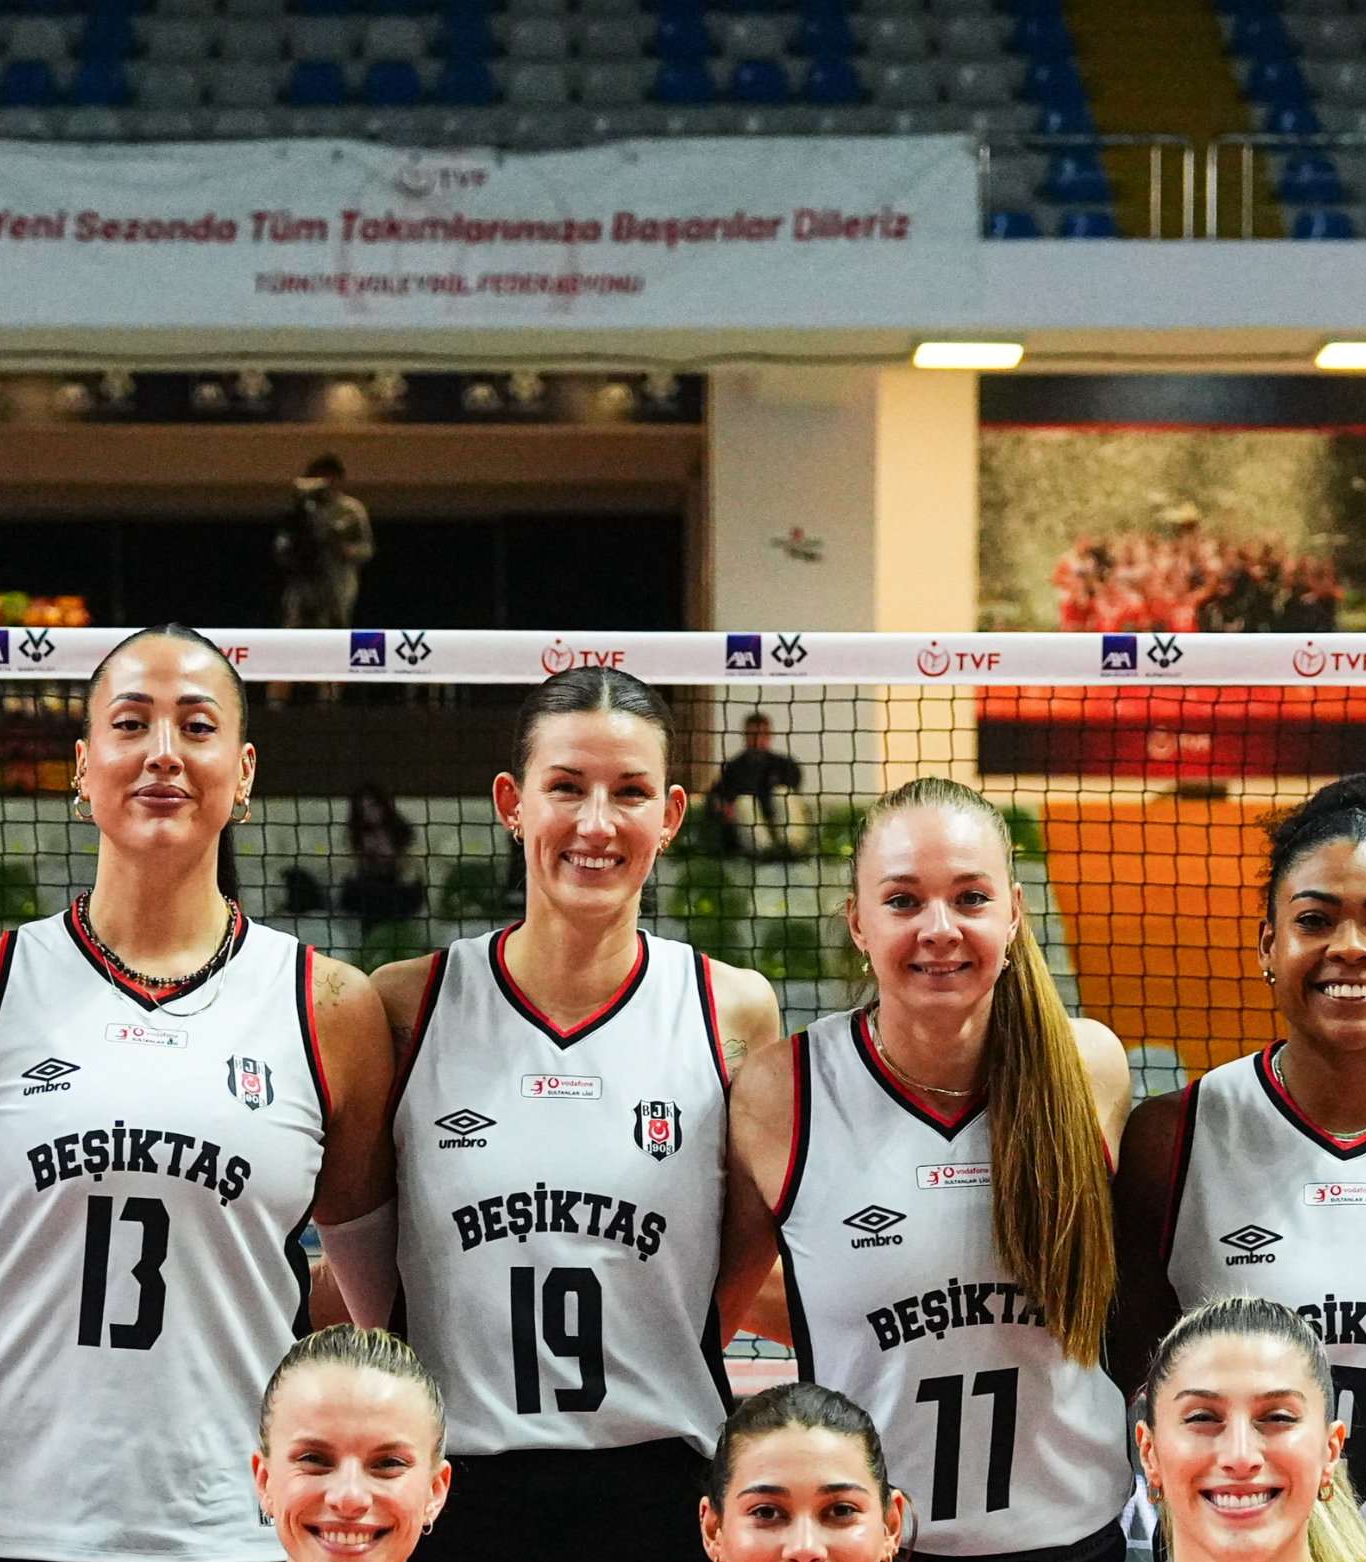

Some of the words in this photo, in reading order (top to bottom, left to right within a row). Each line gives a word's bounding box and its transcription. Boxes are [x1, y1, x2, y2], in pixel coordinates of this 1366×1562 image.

[221, 647, 250, 665] VF
[955, 652, 1002, 671] TVF
[23, 1081, 71, 1096] umbro
[560, 1080, 594, 1088] vodafone
[642, 1104, 673, 1119] BJK
[439, 1136, 487, 1149] umbro
[646, 1142, 673, 1154] 1903
[26, 1120, 252, 1207] BEŞİKTAŞ
[956, 1167, 989, 1175] vodafone
[452, 1182, 667, 1262] BEŞİKTAŞ
[851, 1233, 903, 1249] umbro
[1225, 1250, 1276, 1266] umbro
[78, 1195, 170, 1350] 13
[509, 1266, 607, 1415] 19
